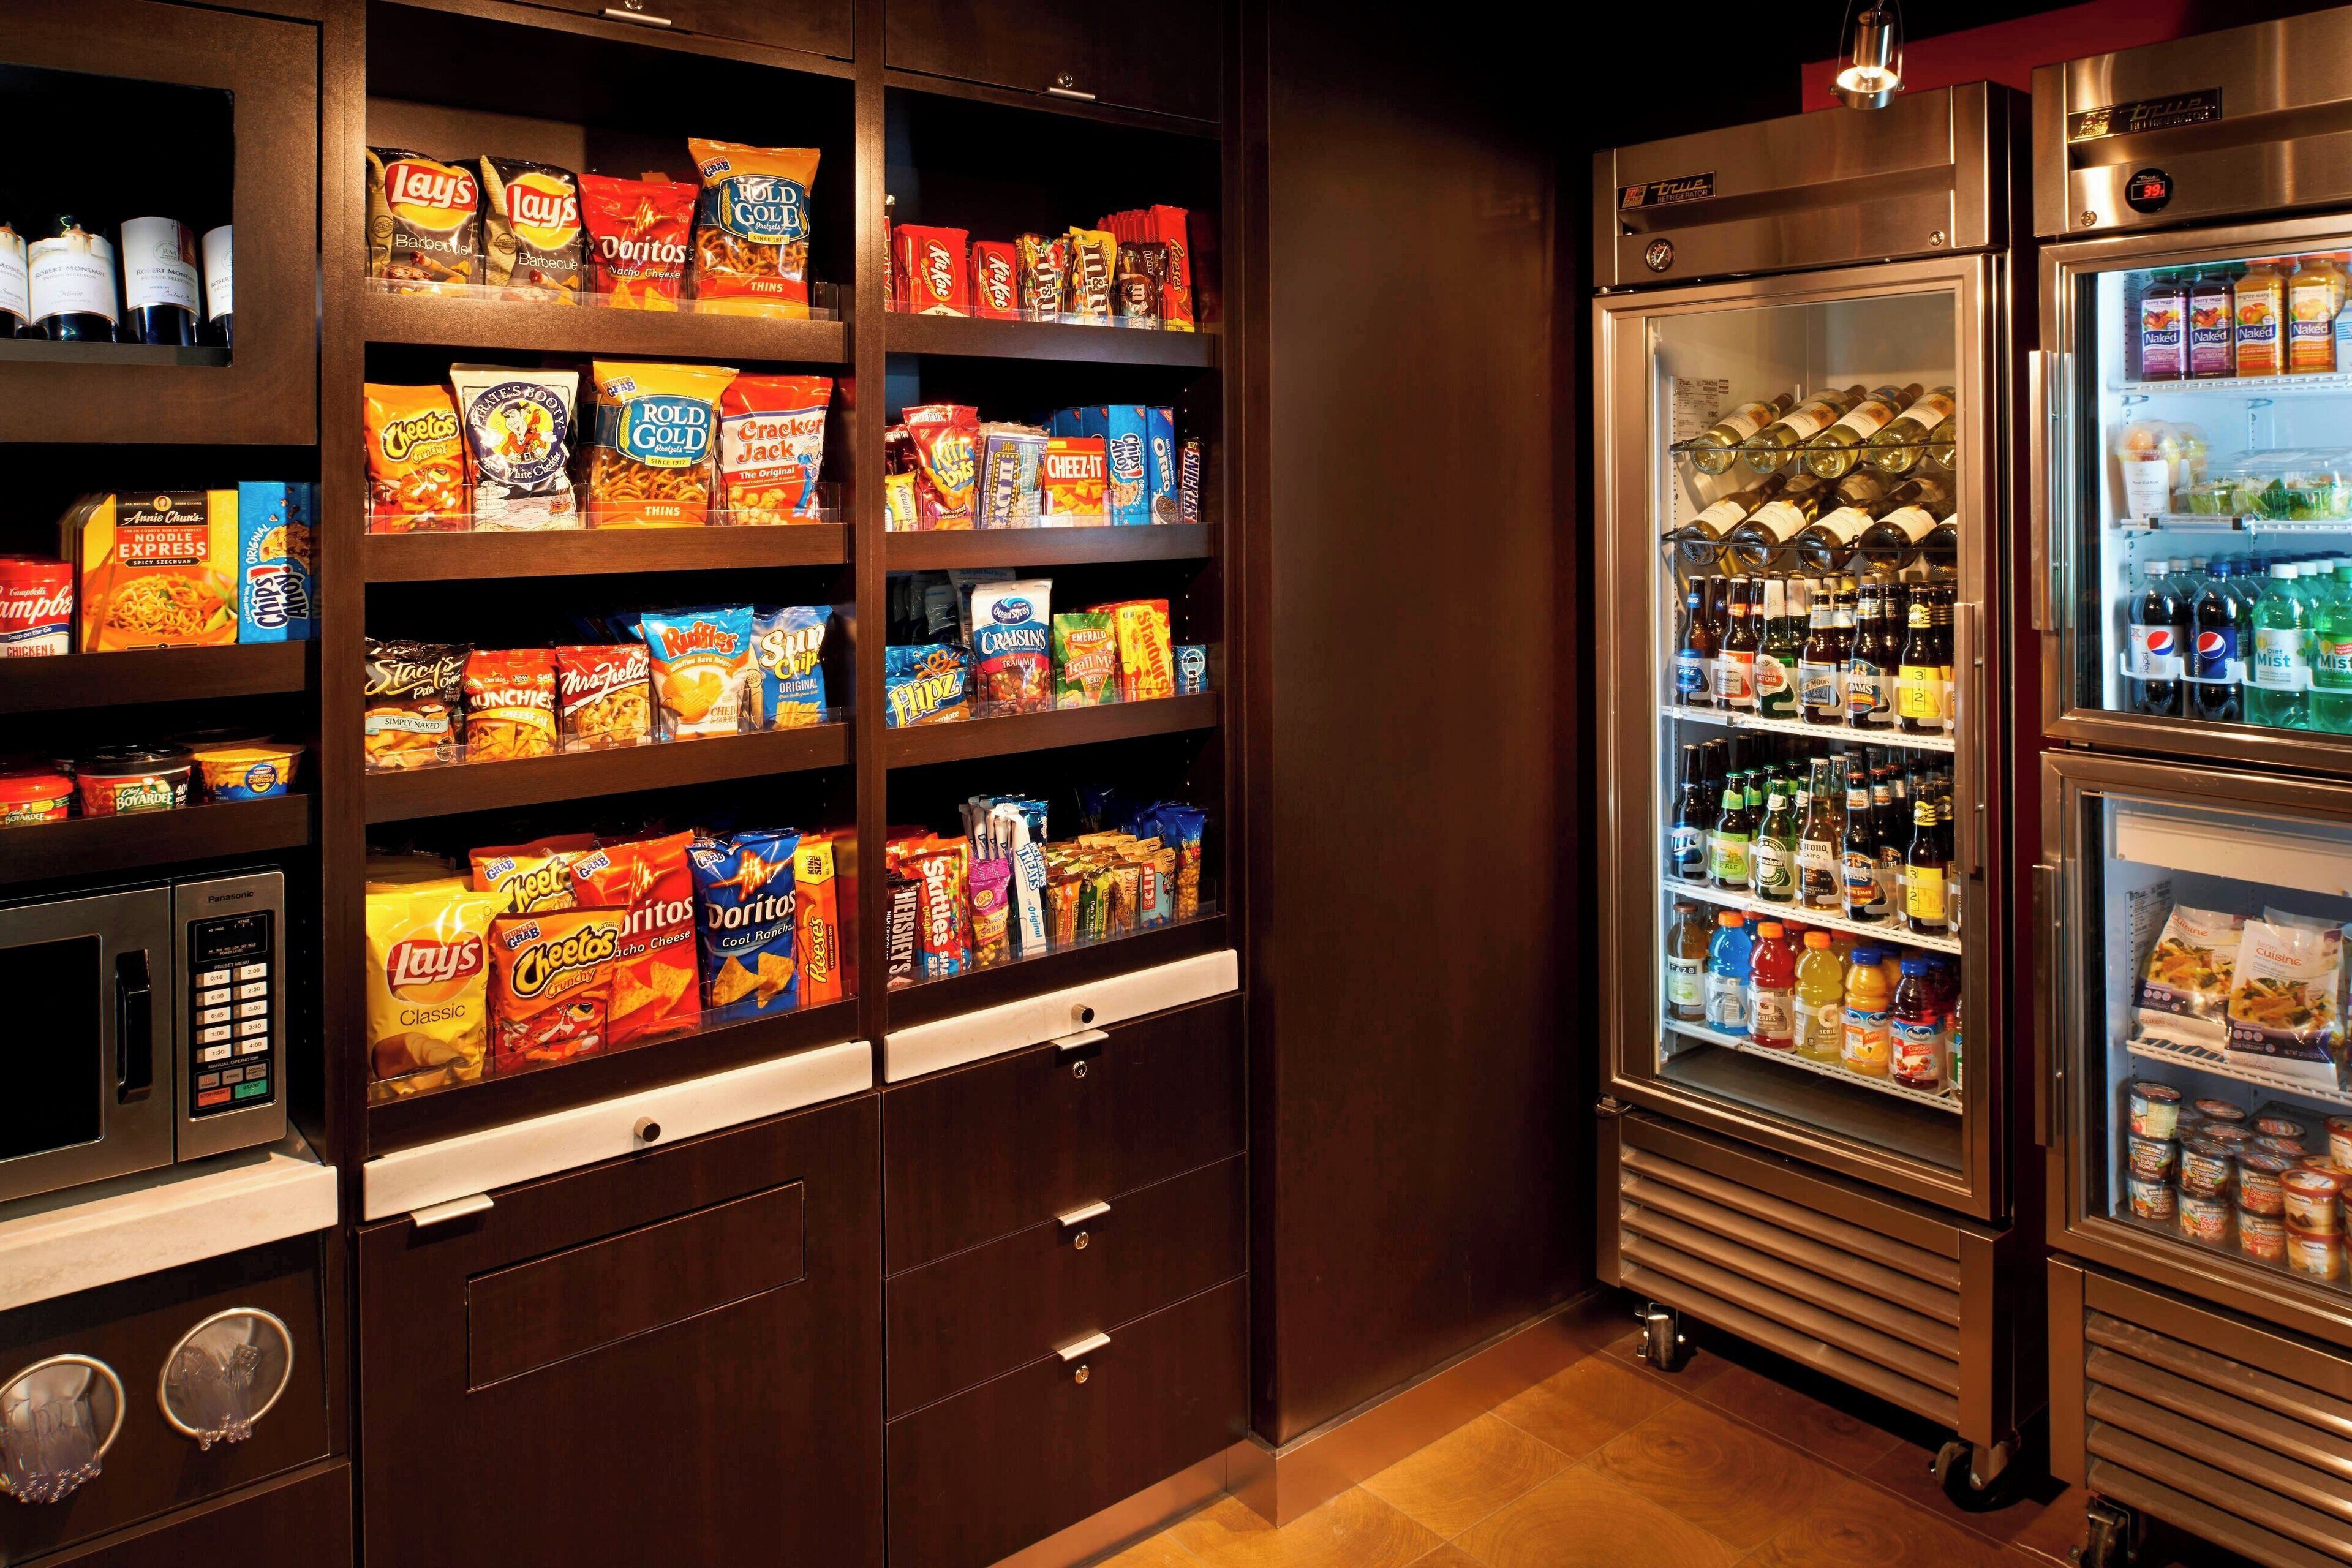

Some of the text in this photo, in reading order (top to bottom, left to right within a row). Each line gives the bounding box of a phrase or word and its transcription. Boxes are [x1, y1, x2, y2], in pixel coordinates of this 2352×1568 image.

[699, 156, 731, 178] HUNGER GRAB
[391, 165, 473, 208] Lay's
[738, 185, 797, 205] ROLD
[1657, 189, 1708, 203] REFRIGERATOR
[2144, 184, 2160, 197] 39
[513, 186, 577, 228] Lay's
[736, 203, 799, 228] GOLD
[755, 221, 782, 231] Pretzels
[162, 247, 177, 257] RM
[396, 234, 469, 256] Barbecue
[599, 235, 687, 263] Doritos
[36, 264, 105, 279] ROBERT MONDAVI
[519, 252, 578, 271] Barbecue
[609, 264, 681, 280] Nacho Cheese
[1169, 238, 1185, 293] Reese's
[750, 282, 783, 293] THINS
[2146, 332, 2177, 344] Naked
[2195, 330, 2226, 342] Naked
[2239, 326, 2273, 339] Naked
[2293, 323, 2328, 336] Naked
[603, 377, 637, 398] HUNGER GRAB
[525, 386, 565, 425] BOOTY
[643, 404, 706, 426] ROLD
[383, 416, 456, 458] Cheetos
[633, 427, 706, 450] GOLD
[738, 418, 823, 441] Cracker
[411, 443, 447, 463] Crunchy
[654, 444, 683, 454] Pretzels
[736, 439, 794, 465] Jack
[1121, 433, 1140, 470] Chips
[505, 451, 562, 480] White Cheddar
[759, 466, 795, 478] Original
[939, 460, 974, 488] bits
[1047, 454, 1102, 478] CHEEZ-IT
[1152, 437, 1170, 492] OREO
[1133, 479, 1145, 507] ORIGINAL
[1183, 450, 1200, 522] SNICKERS
[121, 510, 204, 526] Annie Chun's
[644, 507, 680, 516] THINS
[135, 532, 192, 542] NOODLE
[246, 524, 271, 564] ORIGINAL
[119, 542, 206, 559] EXPRESS
[9, 586, 47, 597] Campbell's
[256, 578, 288, 628] Chips
[993, 605, 1030, 620] Ocean Spray
[8, 632, 23, 641] Soup
[661, 621, 739, 659] Ruffles
[761, 624, 827, 667] Sun
[981, 628, 1046, 655] CRAISINS
[1072, 630, 1107, 642] EMERALD
[7, 643, 55, 657] CHICKEN &
[2258, 654, 2291, 667] Mist
[1003, 658, 1022, 668] TRAIL
[1066, 655, 1096, 673] Trail
[365, 657, 464, 696] Stacy's
[440, 674, 461, 689] Chips
[484, 676, 507, 684] Doritos
[780, 679, 818, 693] ORIGINAL
[1085, 677, 1104, 685] BERRY
[413, 685, 435, 699] Pita
[890, 673, 962, 726] Flipz
[385, 718, 440, 729] SIMPLY NAKED
[116, 791, 174, 812] BOYARDEE
[122, 786, 142, 798] Chef
[5, 812, 45, 824] BOYARDEE
[1800, 841, 1827, 852] Corona
[486, 859, 515, 880] GRAB
[579, 856, 609, 878] GRAB
[1016, 845, 1039, 891] TREATS
[1143, 864, 1155, 899] CLIF
[207, 890, 254, 903] Panasonic
[922, 860, 951, 948] Skittles
[706, 889, 796, 930] Doritos
[981, 924, 1001, 938] Salty
[1027, 905, 1042, 938] Original
[2172, 913, 2208, 937] cuisine
[504, 921, 540, 949] HUNGER GRAB
[650, 929, 691, 949] Cheese
[722, 924, 788, 948] Cool Ranch
[889, 891, 917, 976] HERSHEY'S
[805, 916, 827, 983] Reese's
[2255, 946, 2302, 967] cuisine
[2258, 939, 2277, 956] lean
[393, 939, 480, 986] Lay's
[513, 930, 617, 996] Cheetos
[1670, 964, 1695, 974] TAZO
[545, 967, 595, 998] Crunchy
[400, 1003, 466, 1027] Classic
[207, 1055, 260, 1069] MANUAL OPERATION
